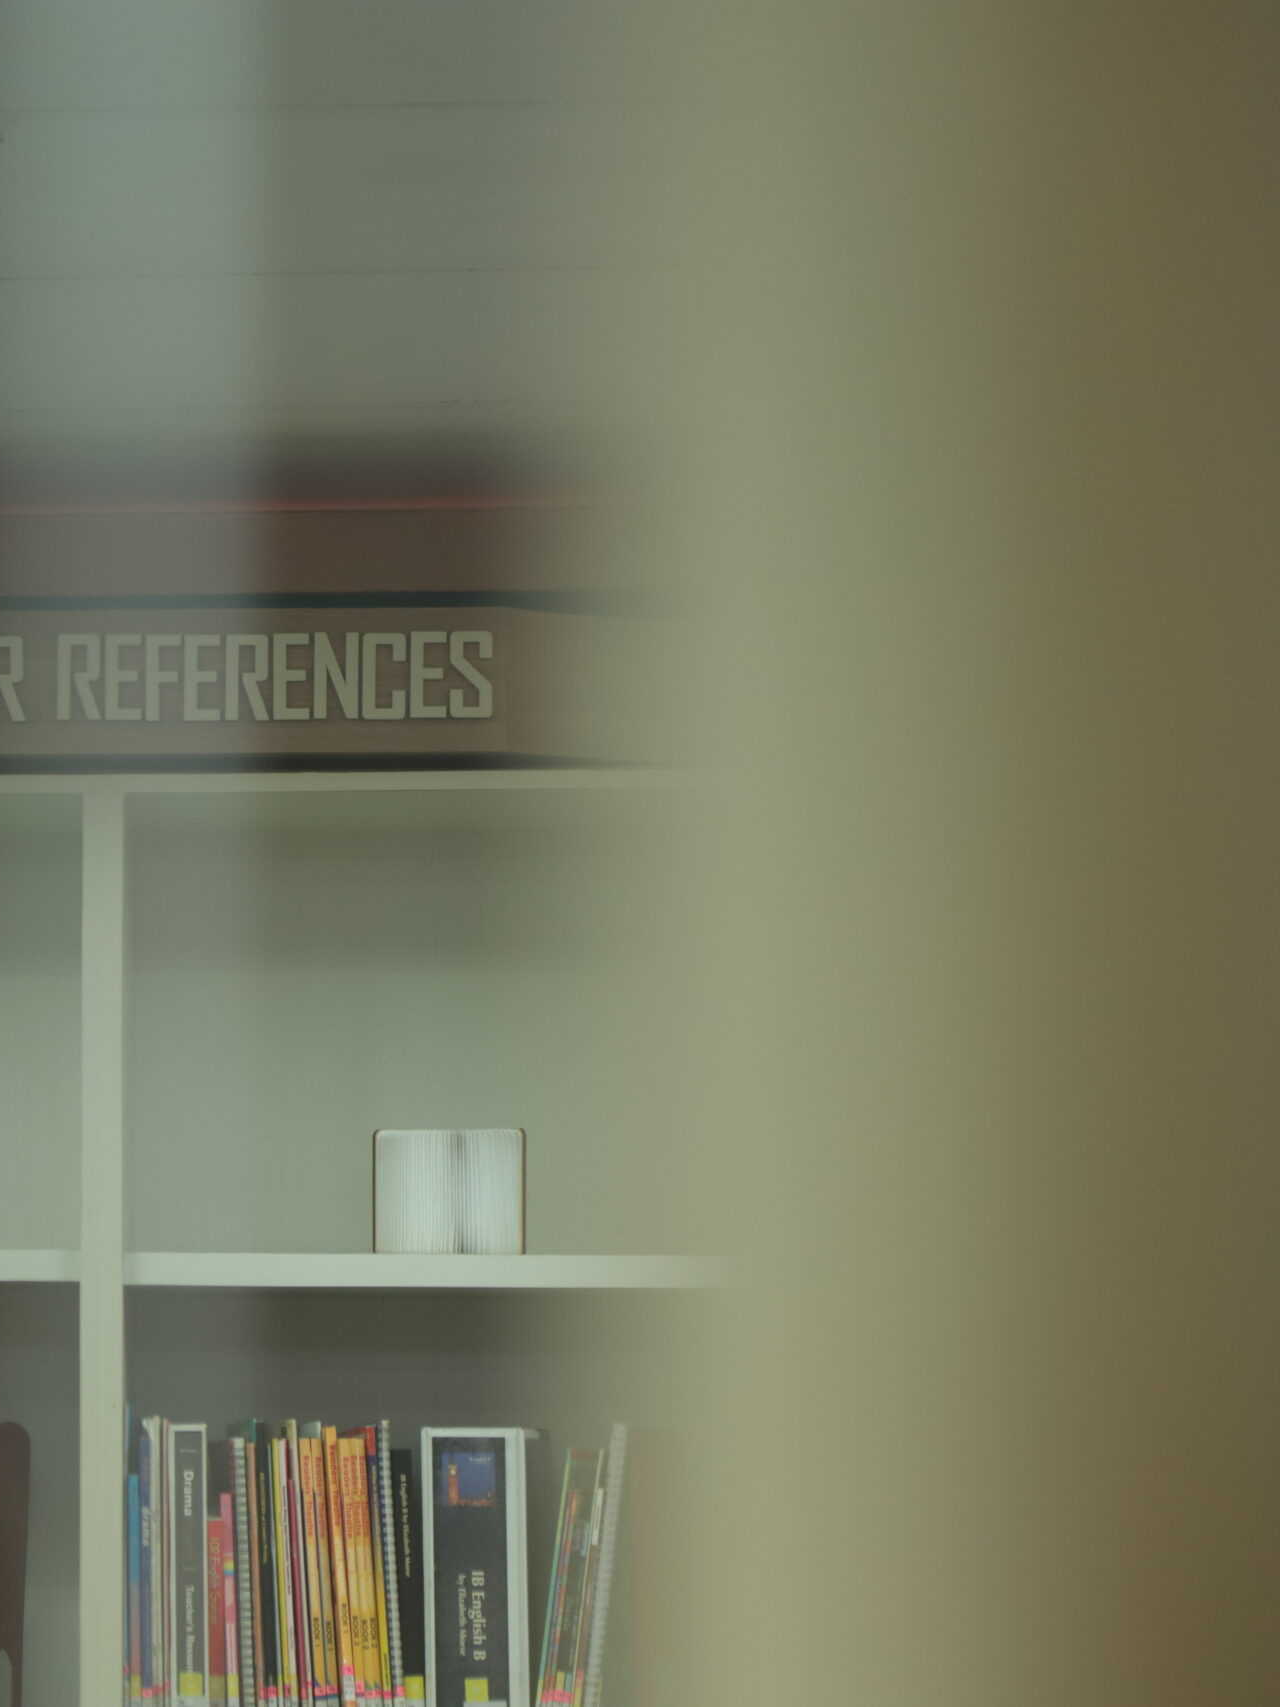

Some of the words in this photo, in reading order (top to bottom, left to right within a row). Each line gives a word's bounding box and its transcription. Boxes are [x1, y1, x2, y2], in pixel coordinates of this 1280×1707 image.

[56, 631, 494, 722] REFERENCES
[183, 1469, 194, 1517] Drama
[399, 1483, 408, 1507] English
[456, 1574, 467, 1585] by
[471, 1570, 485, 1587] IB
[185, 1585, 194, 1632] Teacher's
[458, 1587, 468, 1627] Elizabeth
[468, 1591, 487, 1645] English
[312, 1617, 320, 1639] BOOK
[325, 1621, 333, 1643] BOOK
[352, 1615, 360, 1639] BOOK
[361, 1619, 369, 1643] BOOK
[370, 1617, 378, 1640] BOOK
[473, 1650, 486, 1661] B
